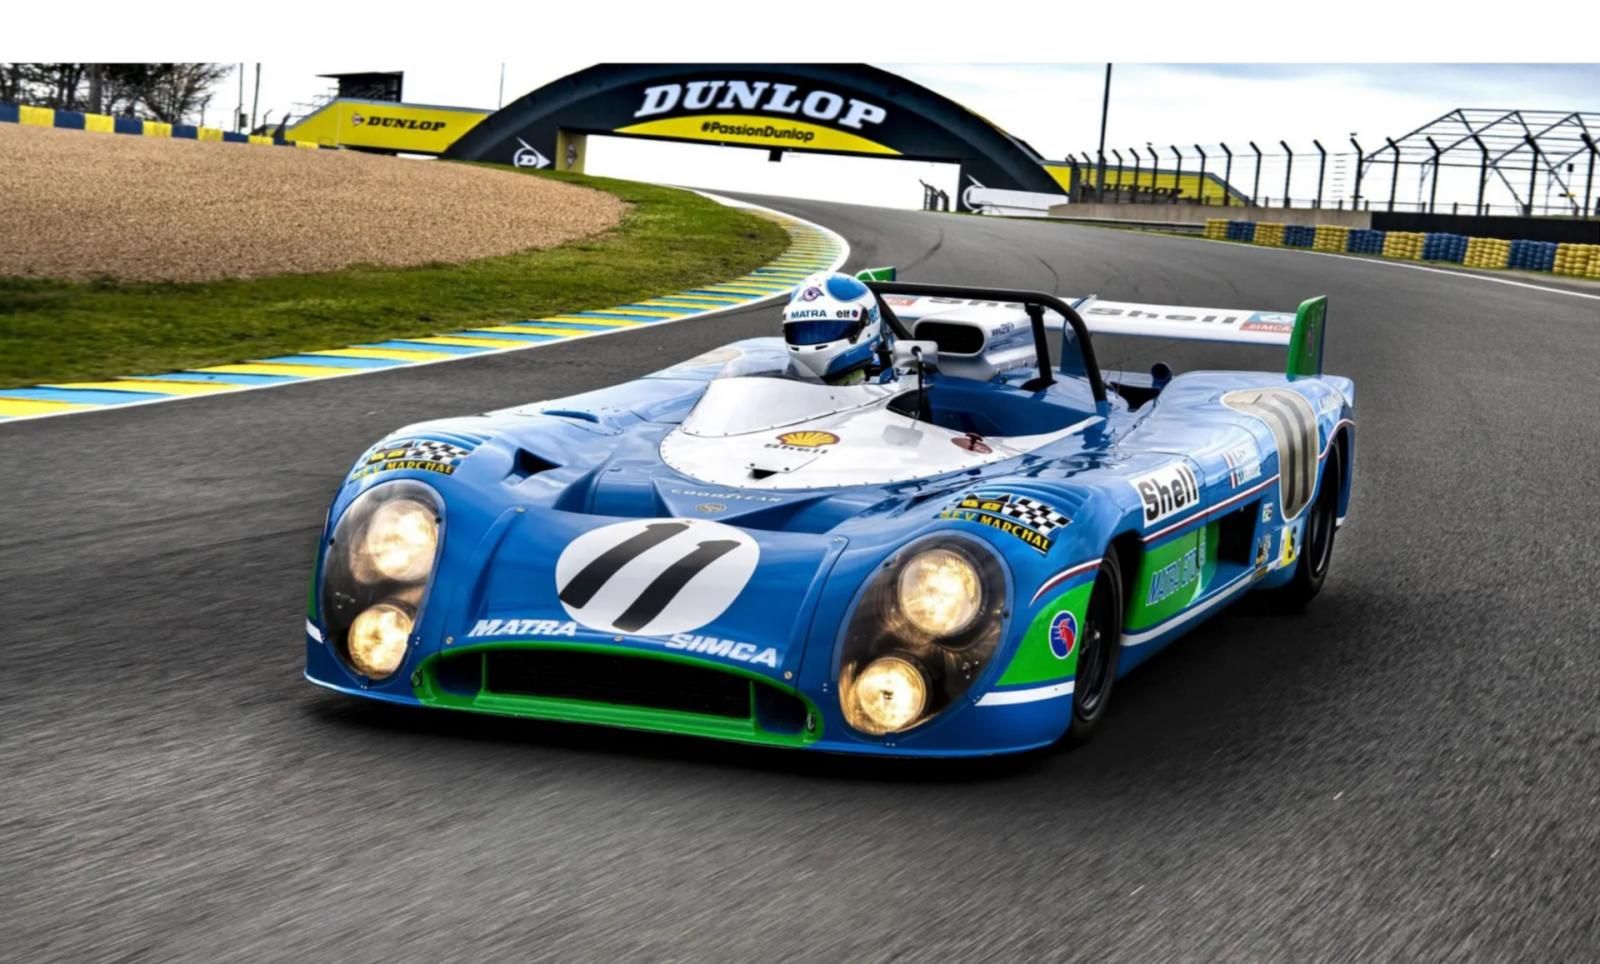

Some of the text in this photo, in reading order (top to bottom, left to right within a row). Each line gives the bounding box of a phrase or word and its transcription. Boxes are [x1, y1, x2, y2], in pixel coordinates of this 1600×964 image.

[634, 80, 887, 129] DUNLOP
[367, 116, 447, 132] DUNLOP
[701, 121, 814, 142] #PassionDunlop
[790, 309, 828, 319] MATRA
[835, 309, 851, 318] elf
[1086, 306, 1238, 325] Shell
[1248, 323, 1291, 333] SIMCA
[385, 461, 454, 475] MARCHAL
[1138, 465, 1198, 521] Shell
[980, 515, 1051, 552] MARCHAL
[558, 522, 742, 633] 11
[467, 618, 578, 639] MATRA
[664, 632, 779, 668] SIMCA
